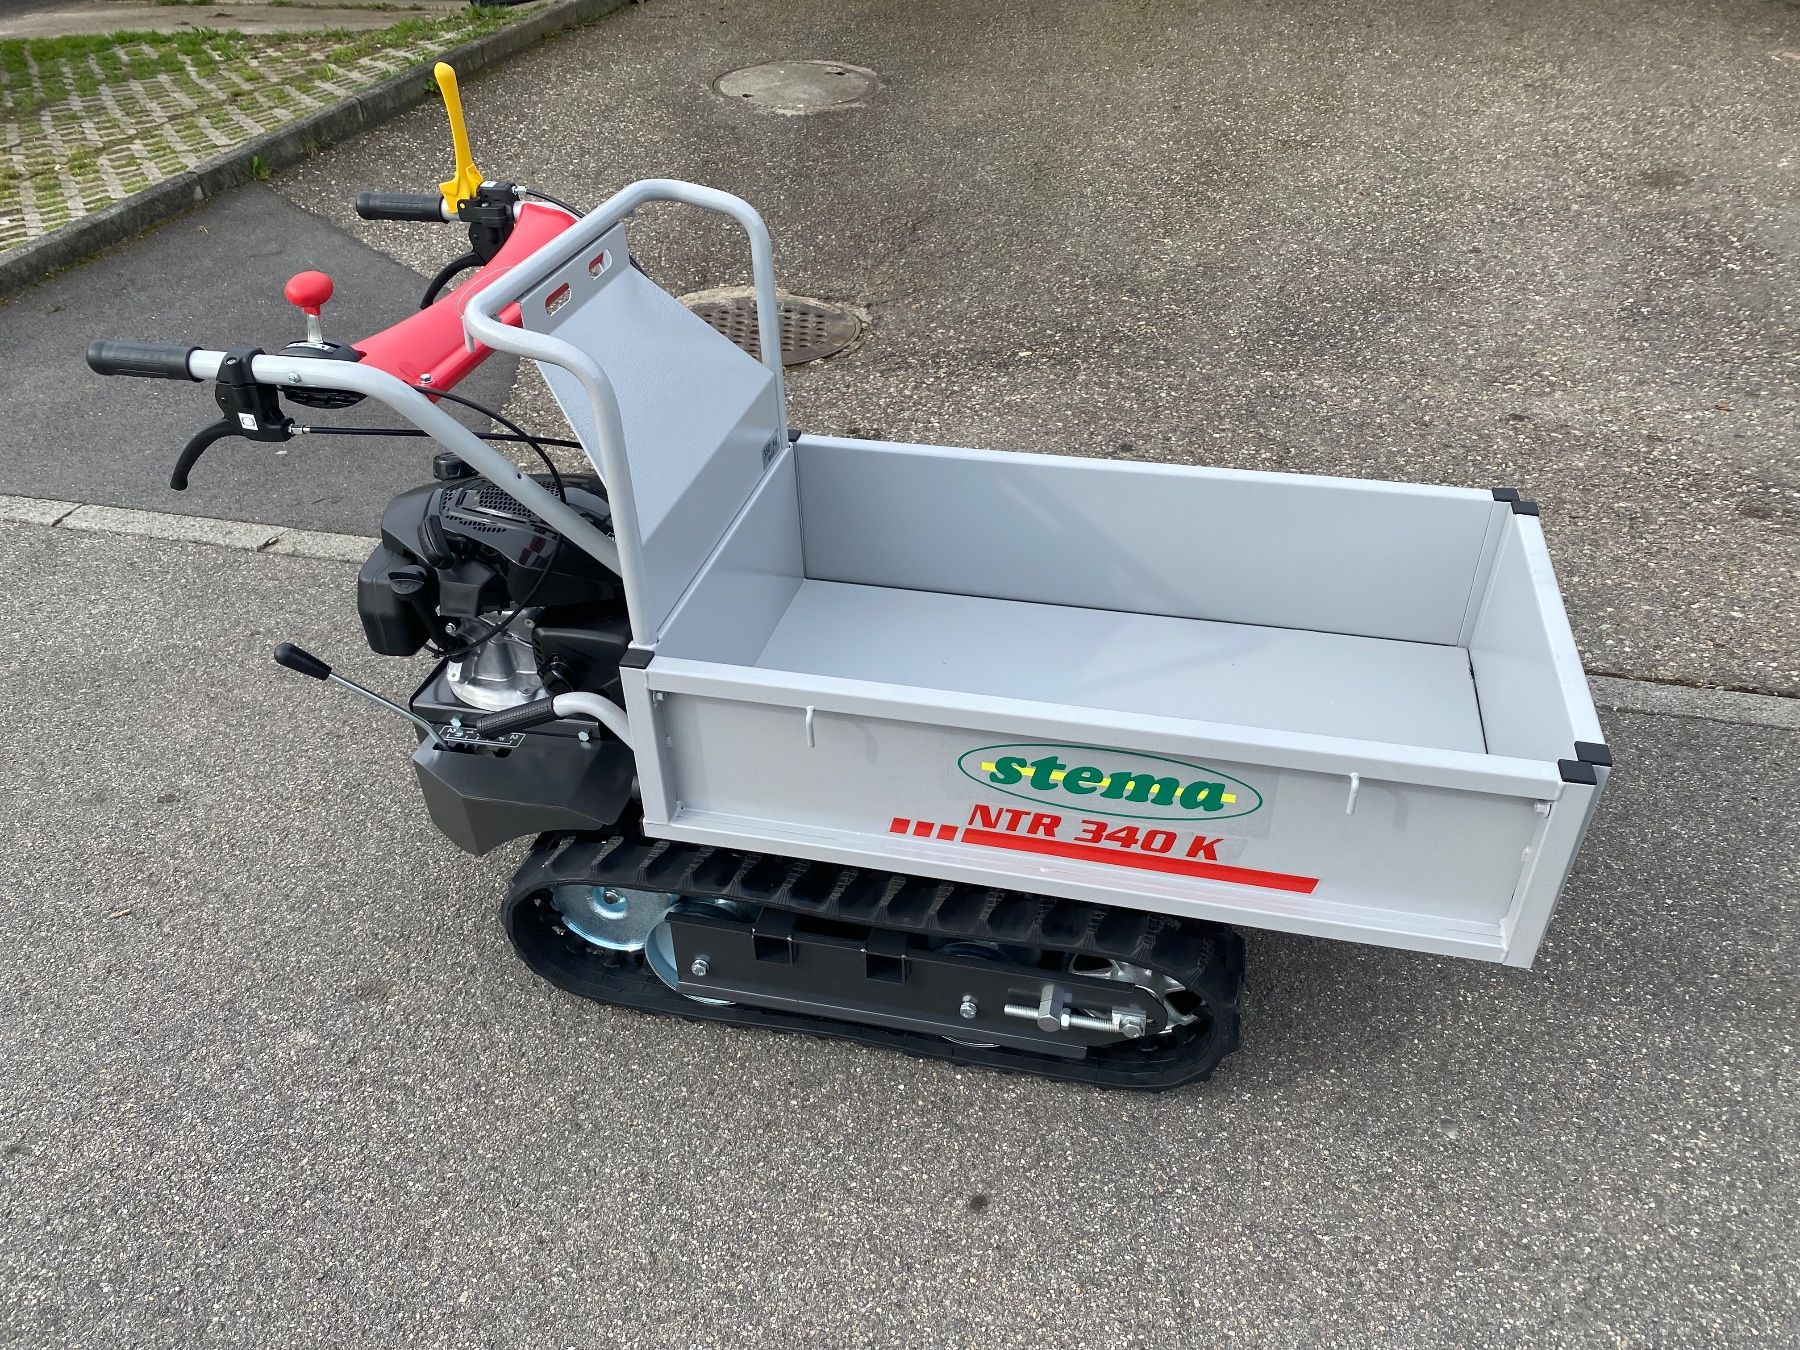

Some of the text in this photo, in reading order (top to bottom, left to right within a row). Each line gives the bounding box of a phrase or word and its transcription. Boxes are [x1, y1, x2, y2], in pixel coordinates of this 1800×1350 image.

[988, 756, 1227, 811] stema
[968, 804, 1222, 861] NTR 340 K
